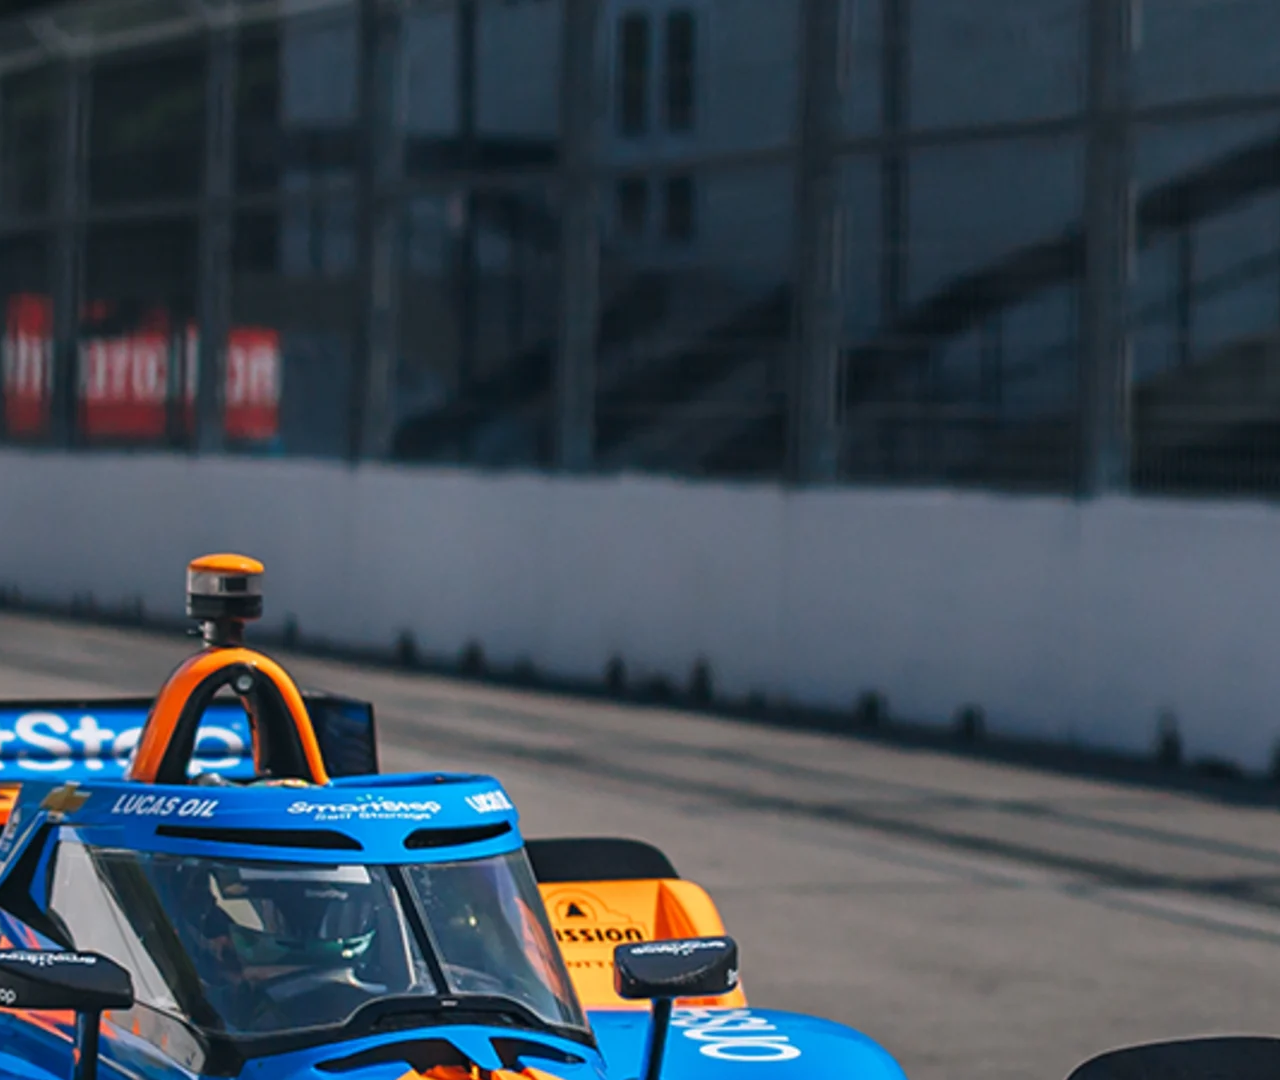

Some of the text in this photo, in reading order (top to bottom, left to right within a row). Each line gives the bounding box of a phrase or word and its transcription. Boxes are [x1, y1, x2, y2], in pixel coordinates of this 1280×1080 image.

[111, 794, 219, 817] LUCAS OIL
[287, 798, 442, 815] SmartStop
[554, 927, 644, 942] ission
